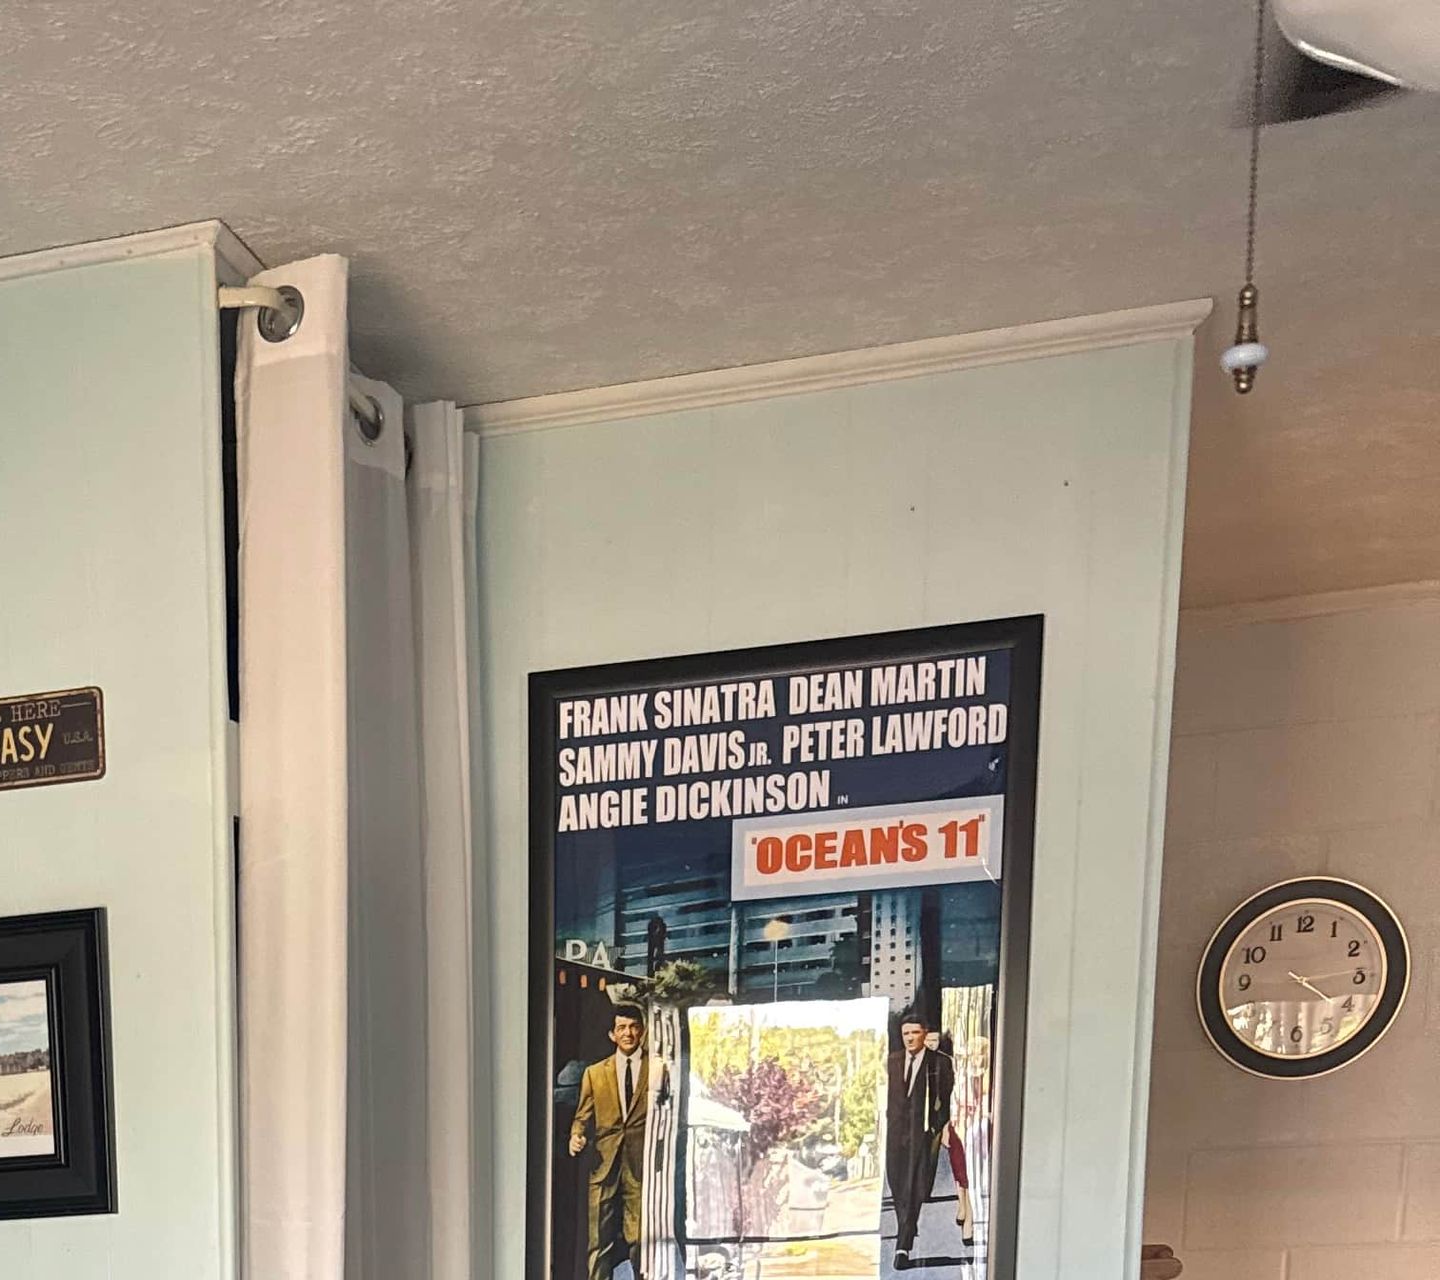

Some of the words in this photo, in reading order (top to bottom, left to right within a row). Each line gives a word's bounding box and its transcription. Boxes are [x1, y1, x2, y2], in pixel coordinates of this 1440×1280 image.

[559, 692, 649, 740] FRANK
[654, 678, 777, 730] SINATRA
[789, 669, 863, 716] DEAN
[870, 655, 987, 707] MARTIN
[11, 700, 61, 723] HERE
[559, 738, 658, 787] SAMMY
[663, 730, 746, 776] DAVIS
[747, 741, 772, 767] JR.
[782, 718, 865, 765] PETER
[871, 703, 1008, 755] LAWFORD
[558, 786, 649, 833] ANGIE
[655, 769, 831, 824] DICKINSON
[837, 794, 849, 806] IN
[1269, 924, 1283, 942] 11
[1296, 915, 1315, 933] 12
[1330, 920, 1337, 938] 1
[1243, 946, 1266, 965] 10
[1348, 940, 1360, 958] 2
[1238, 974, 1252, 991] 9
[1341, 995, 1354, 1013] 4
[1290, 1025, 1303, 1044] 6
[1, 1117, 44, 1137] Lodge
